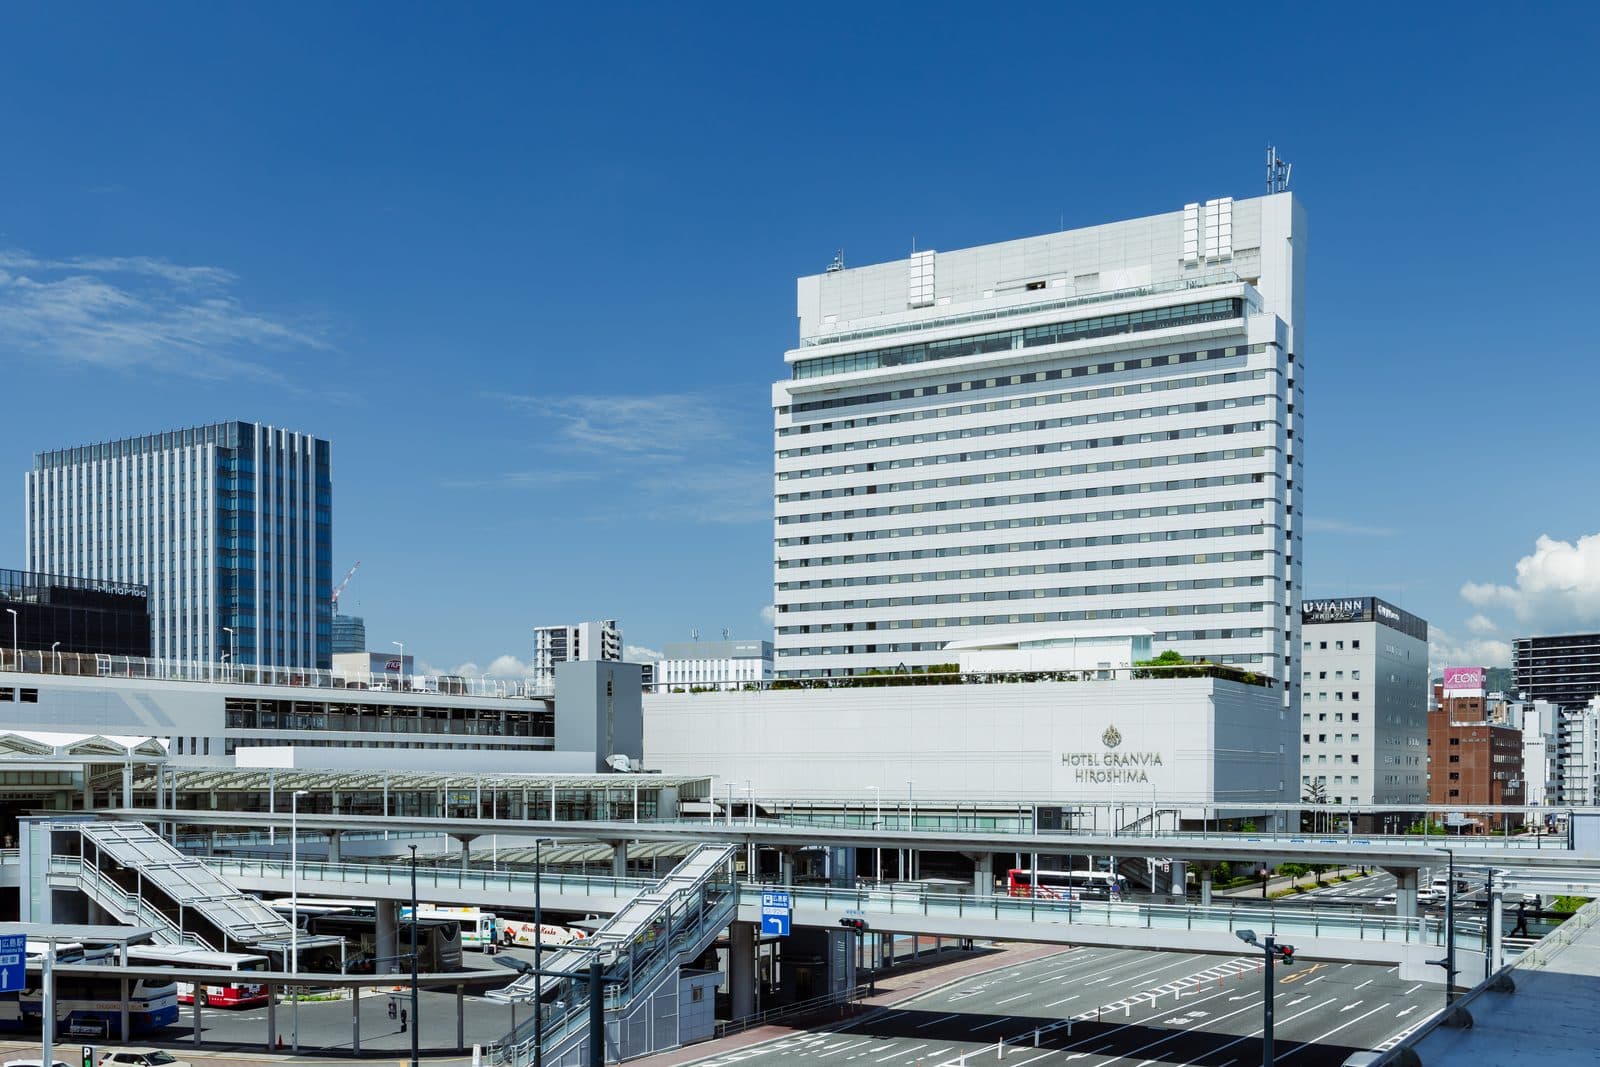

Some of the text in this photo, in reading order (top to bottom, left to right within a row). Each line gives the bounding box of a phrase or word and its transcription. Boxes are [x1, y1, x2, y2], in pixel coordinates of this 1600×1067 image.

[1316, 602, 1337, 612] VIA
[1340, 600, 1362, 611] INN
[1062, 752, 1162, 767] HOTEL GRANVIA
[1075, 769, 1148, 783] HIROSHIMA
[83, 1047, 91, 1058] P
